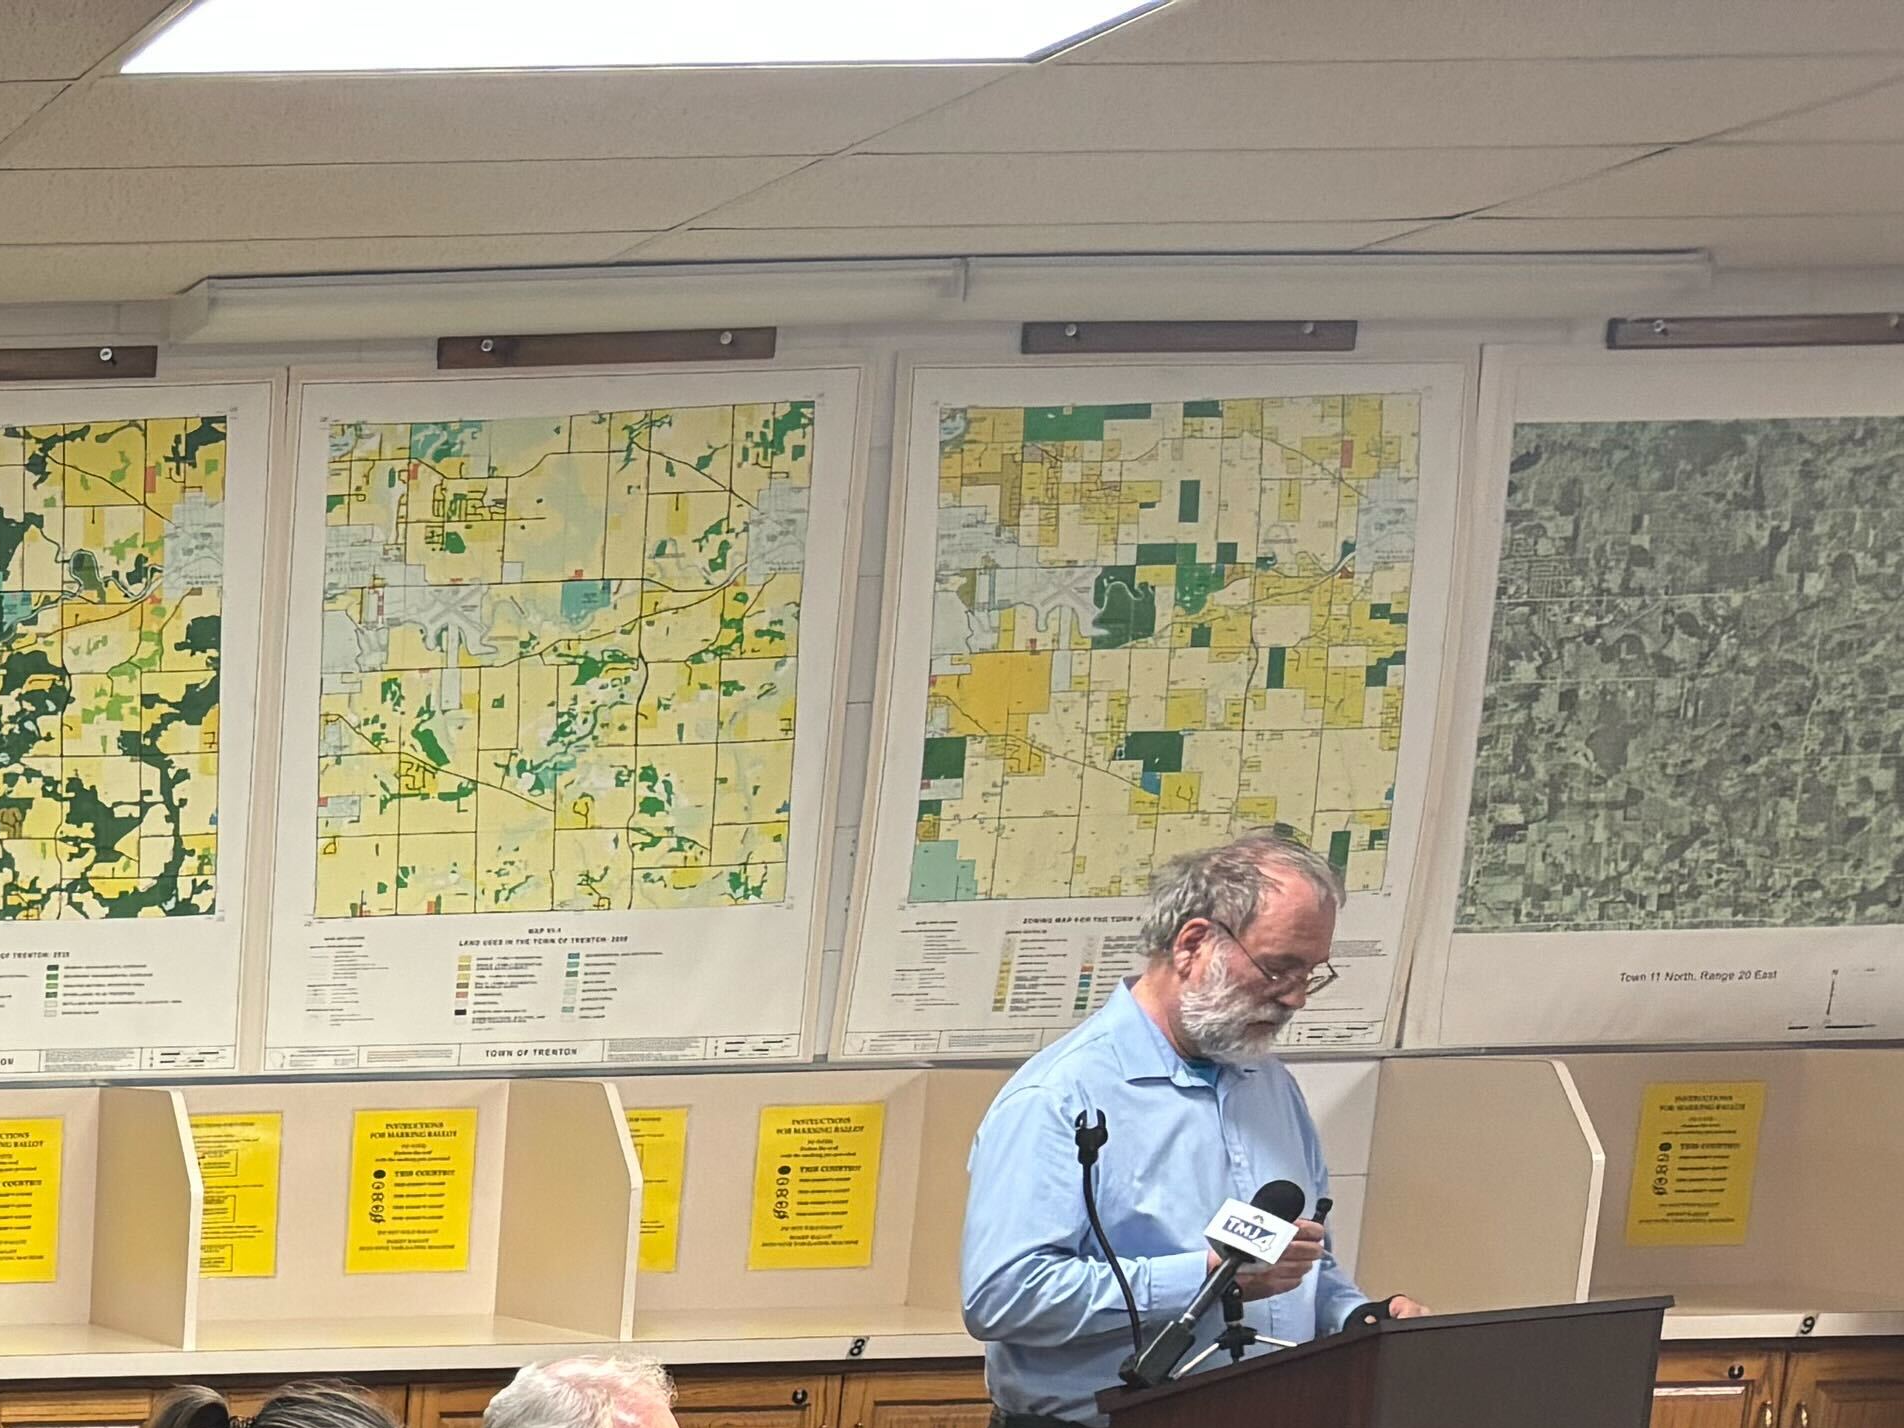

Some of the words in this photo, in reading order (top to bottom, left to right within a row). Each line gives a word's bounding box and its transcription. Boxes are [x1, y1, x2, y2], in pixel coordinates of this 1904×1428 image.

[1620, 972, 1646, 982] Town
[1700, 971, 1735, 982] Range
[1738, 970, 1751, 980] 20
[1754, 970, 1777, 979] East
[517, 1049, 528, 1057] OF
[533, 1048, 577, 1056] TRENTON
[1223, 1215, 1277, 1253] TMJ4
[1800, 1316, 1816, 1335] 9
[849, 1338, 866, 1356] 8
